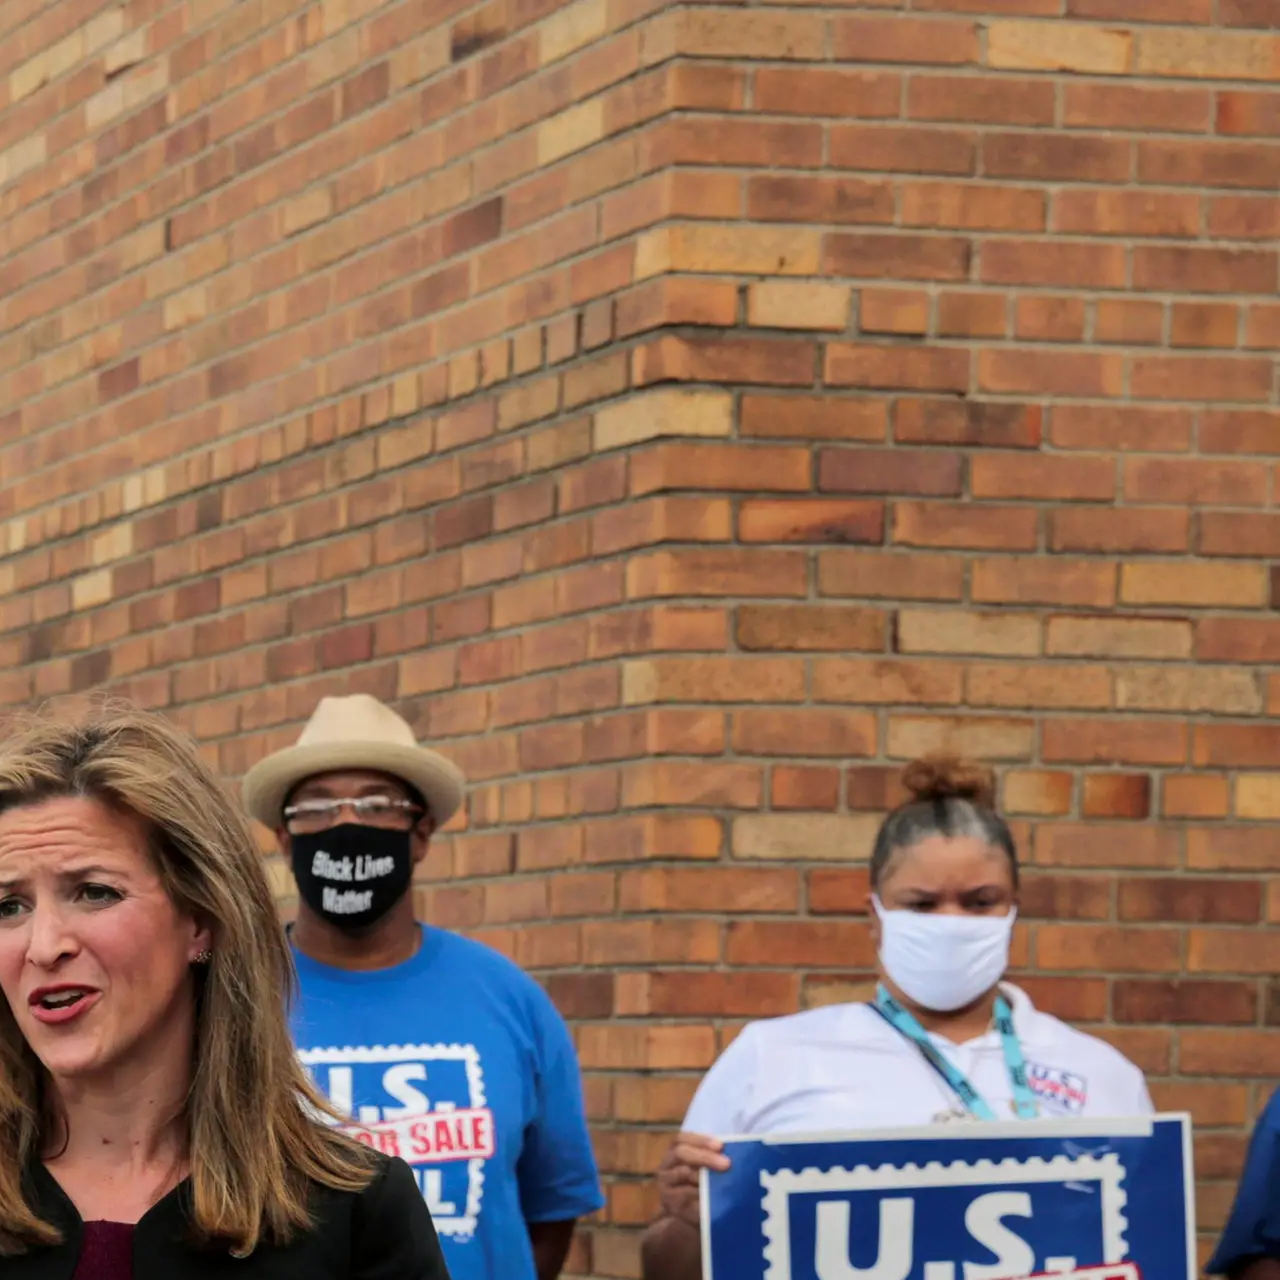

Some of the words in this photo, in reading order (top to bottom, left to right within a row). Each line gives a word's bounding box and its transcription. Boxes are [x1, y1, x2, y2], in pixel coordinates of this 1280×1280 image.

[311, 850, 353, 881] Black
[355, 854, 395, 881] Lives
[323, 886, 373, 914] Matter
[409, 1117, 486, 1155] SALE
